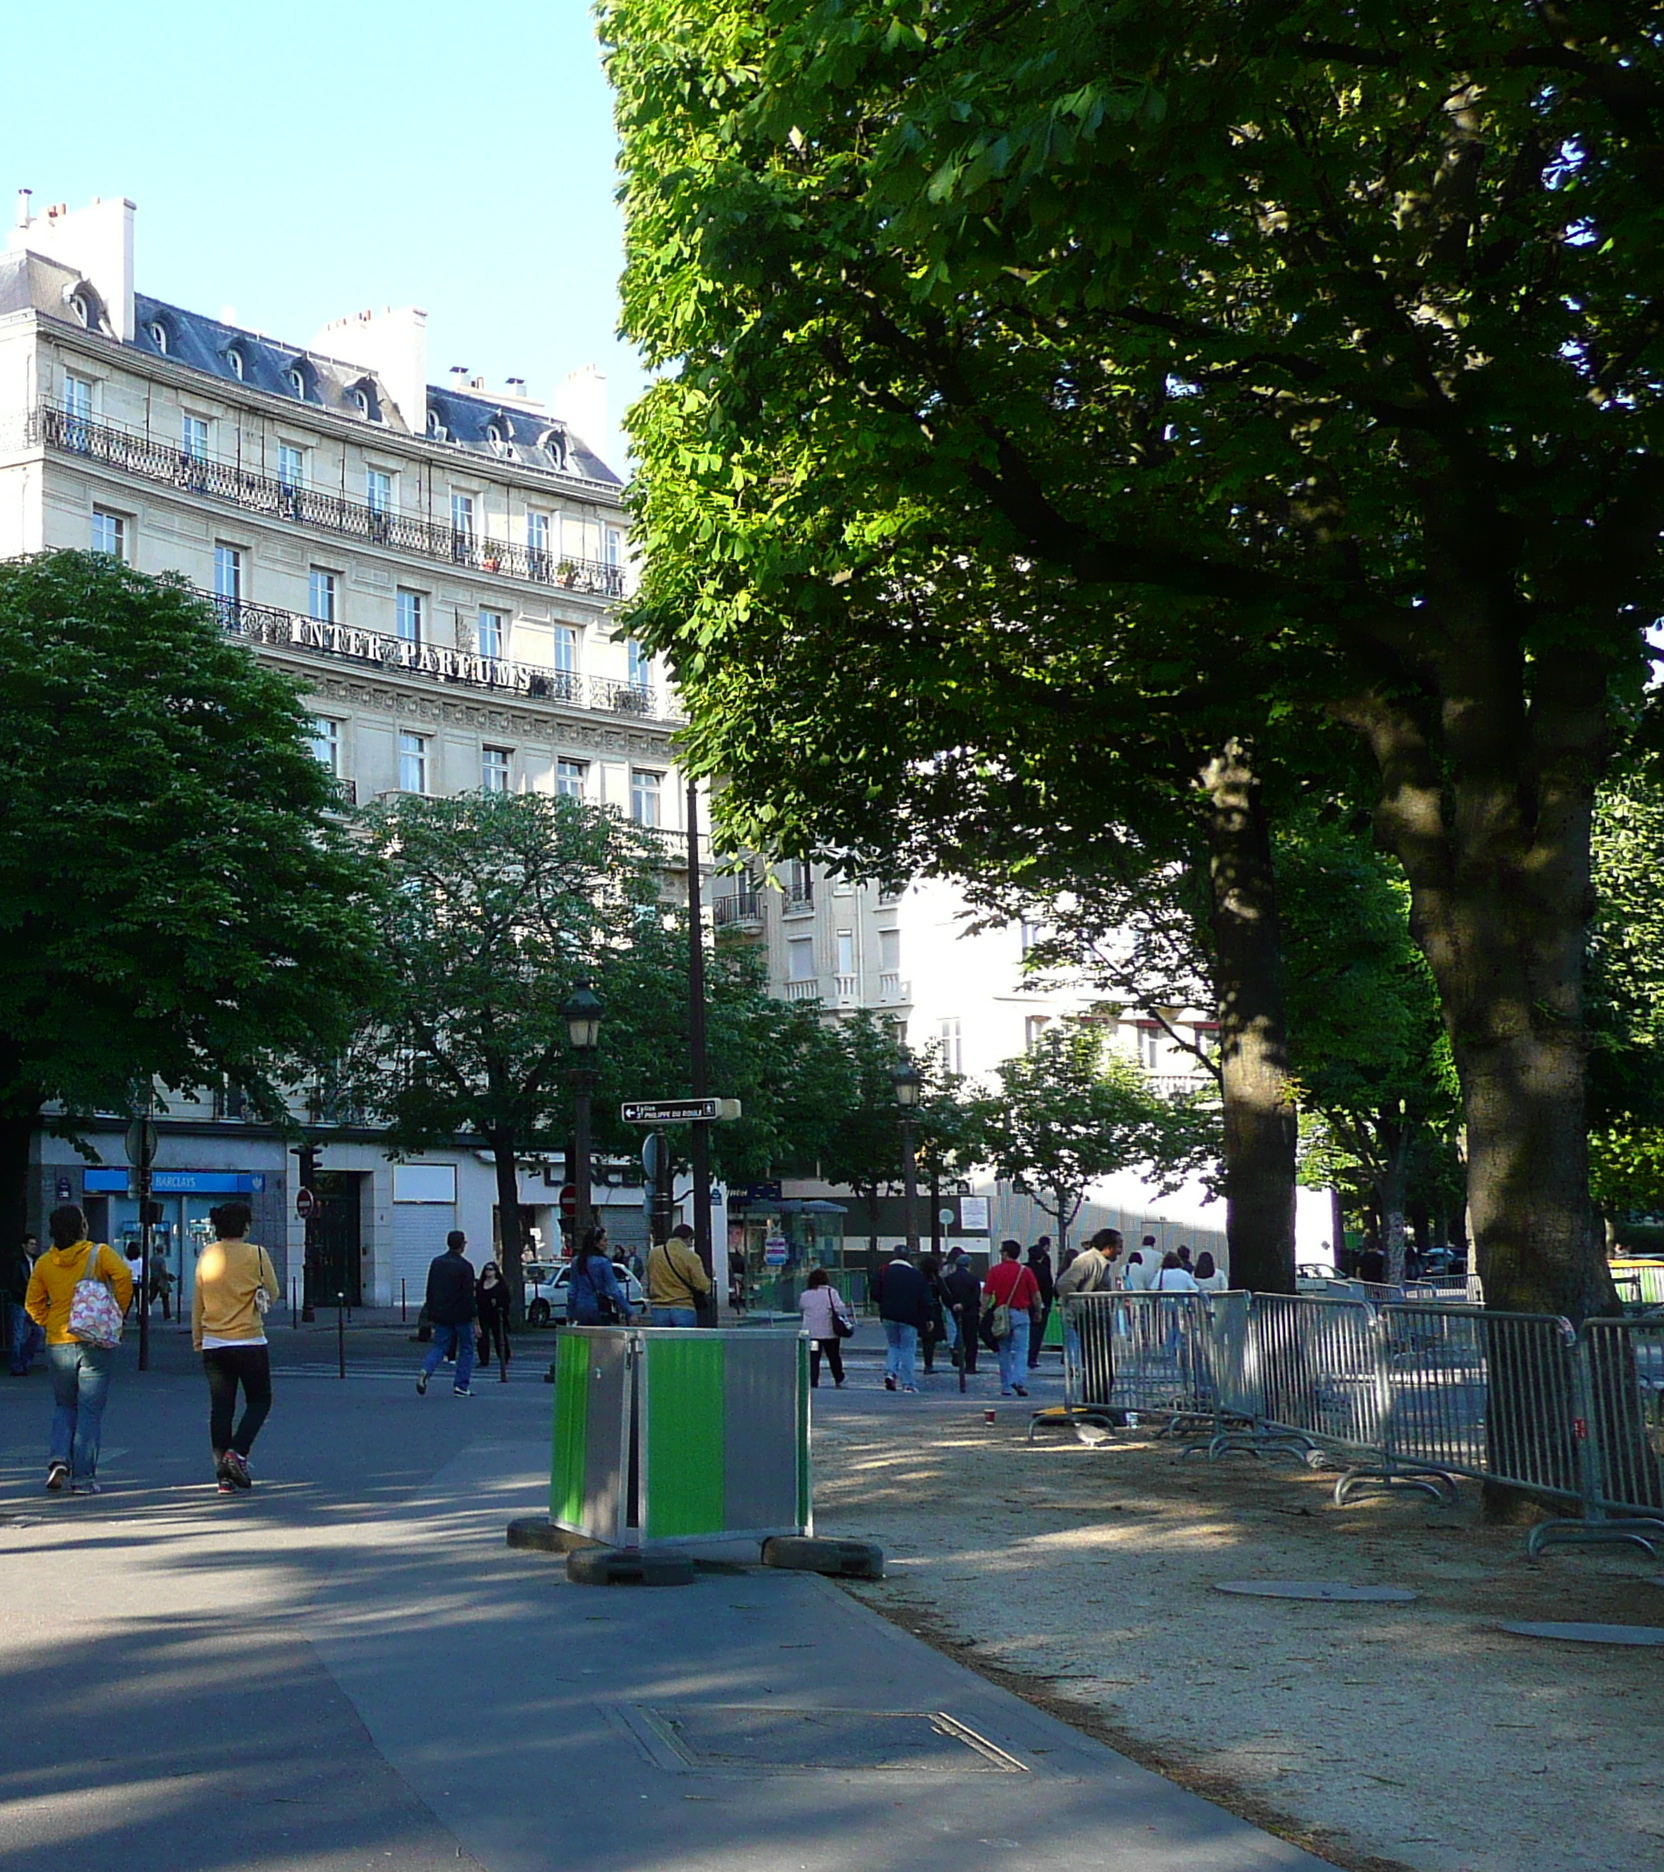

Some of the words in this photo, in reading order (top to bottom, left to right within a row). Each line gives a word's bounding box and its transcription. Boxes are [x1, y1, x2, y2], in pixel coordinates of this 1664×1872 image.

[290, 616, 384, 661] INTER
[399, 640, 532, 690] PARFUMS
[156, 1176, 196, 1187] BARCLAYS
